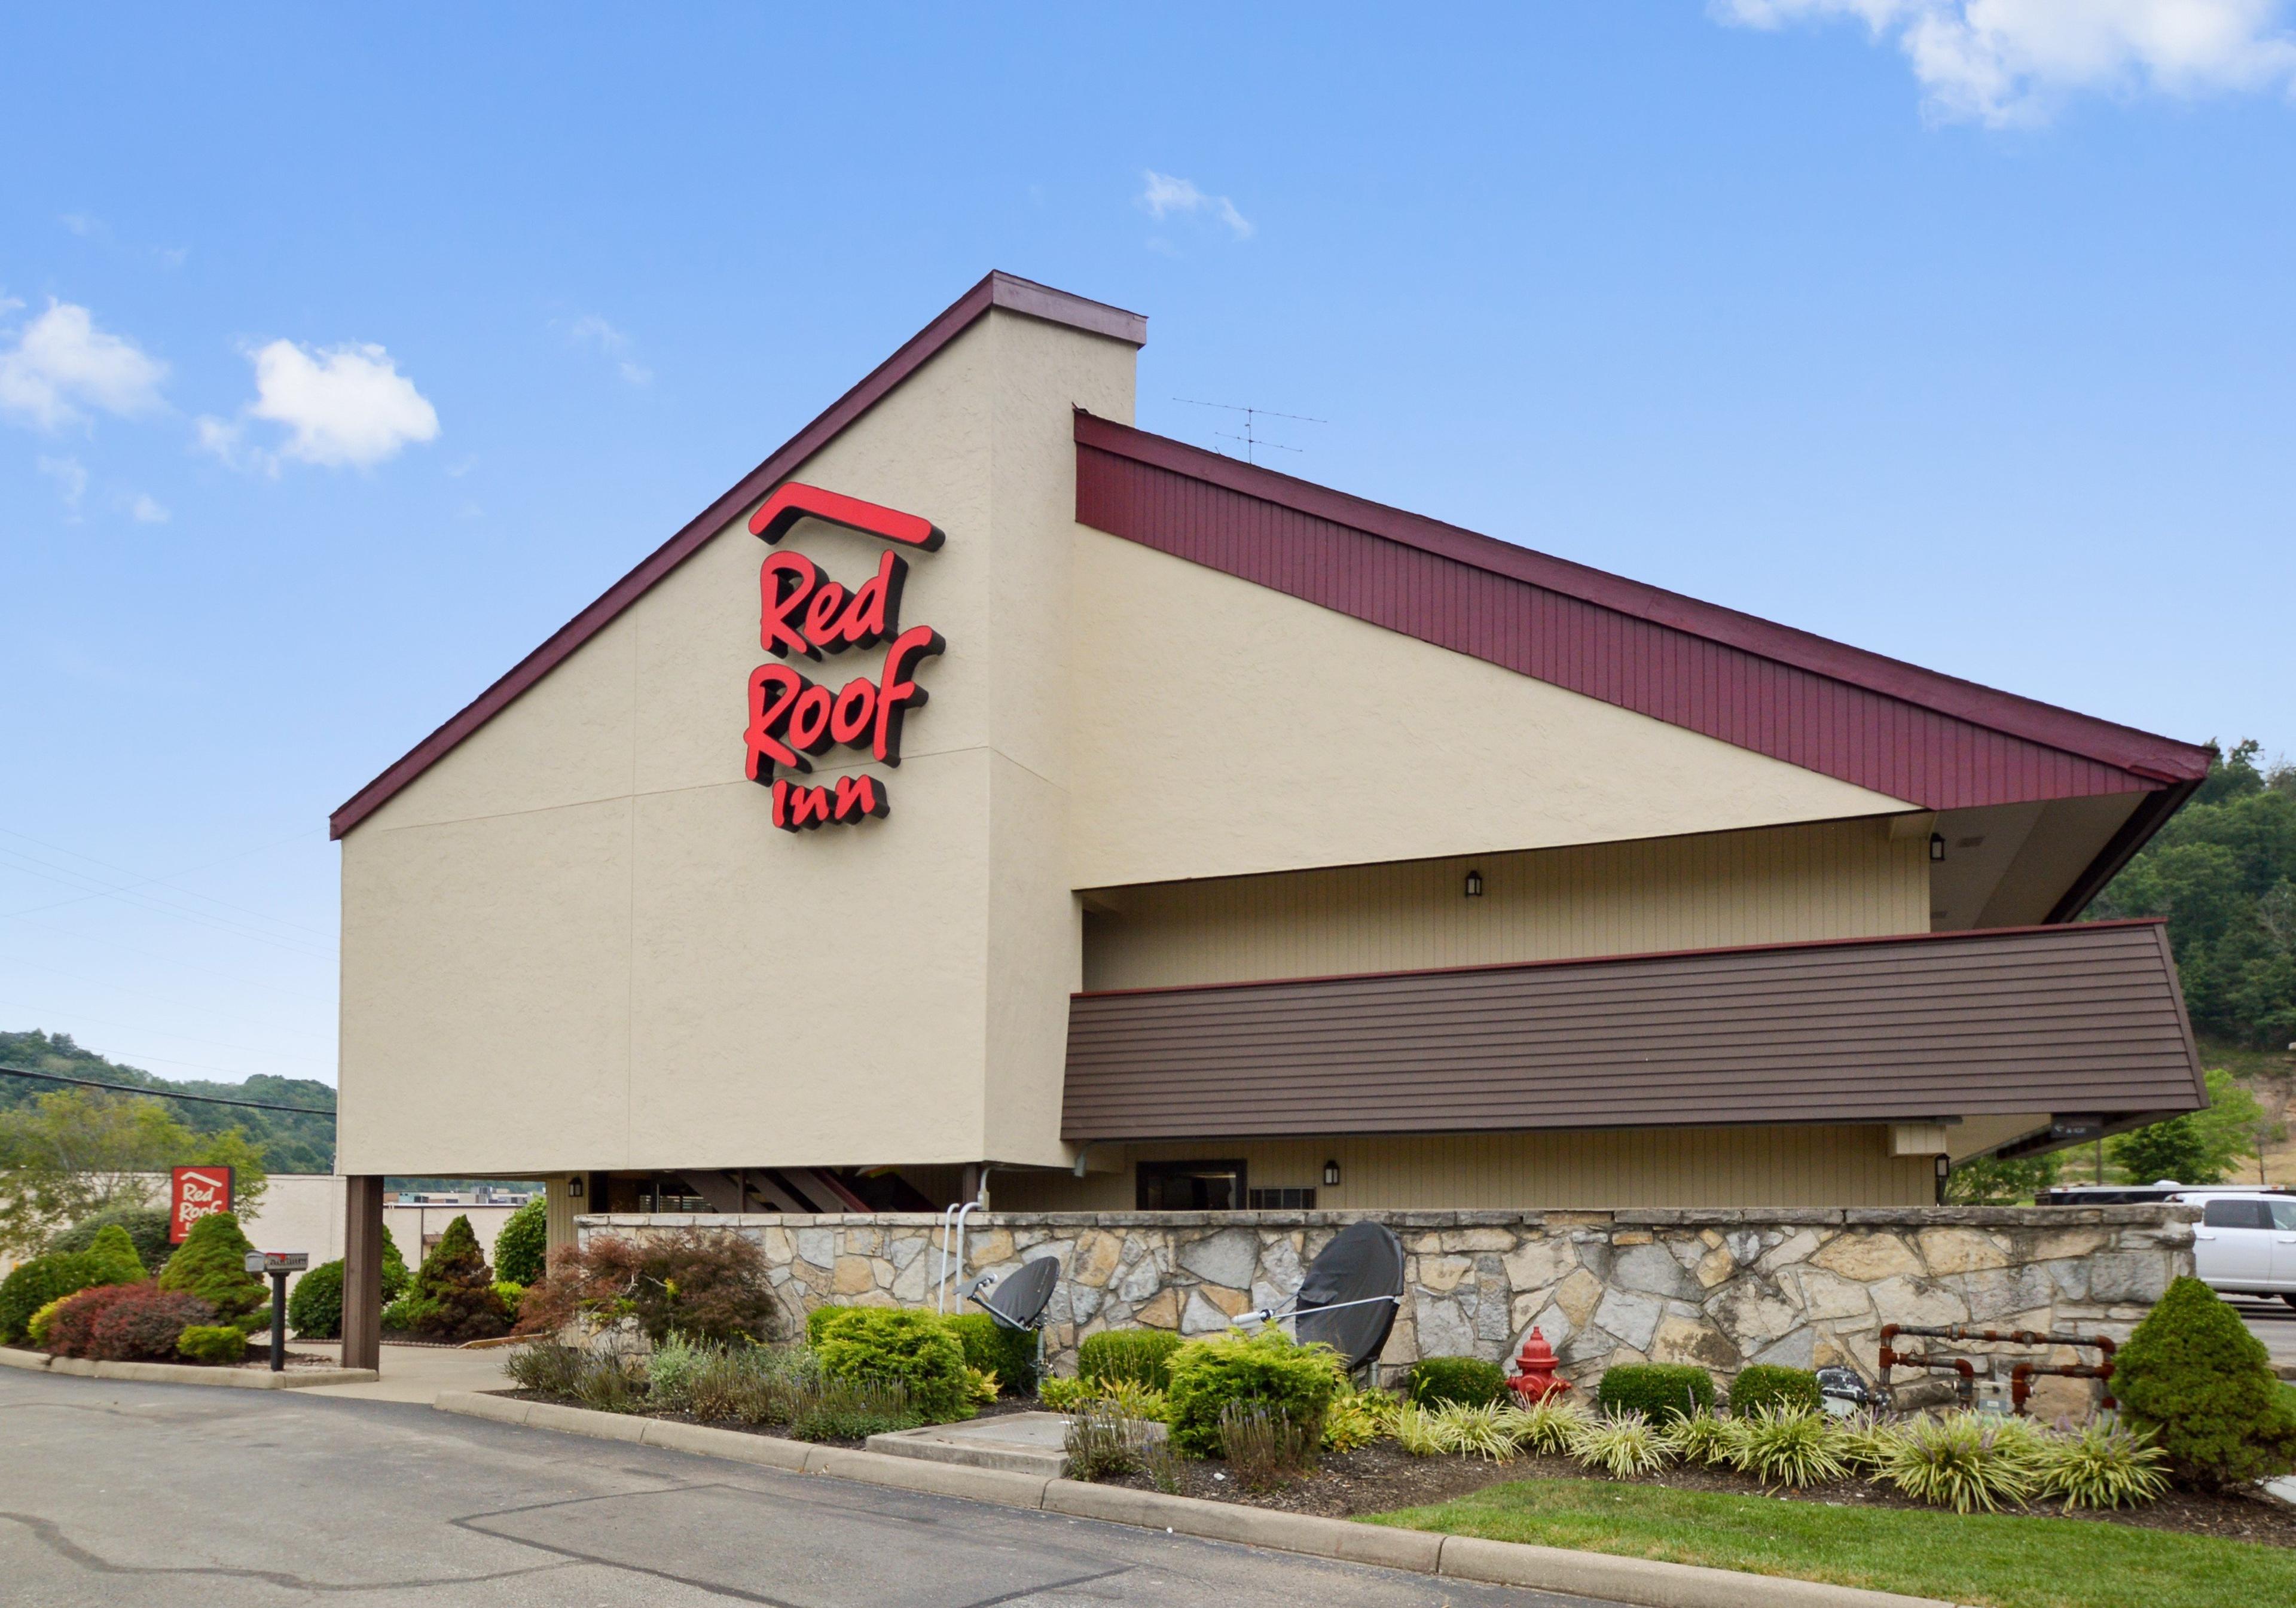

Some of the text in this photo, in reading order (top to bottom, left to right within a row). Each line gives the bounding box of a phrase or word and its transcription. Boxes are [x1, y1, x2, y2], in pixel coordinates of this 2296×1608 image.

[760, 549, 897, 655] Red
[743, 625, 934, 781] Roof
[183, 1183, 214, 1202] Red
